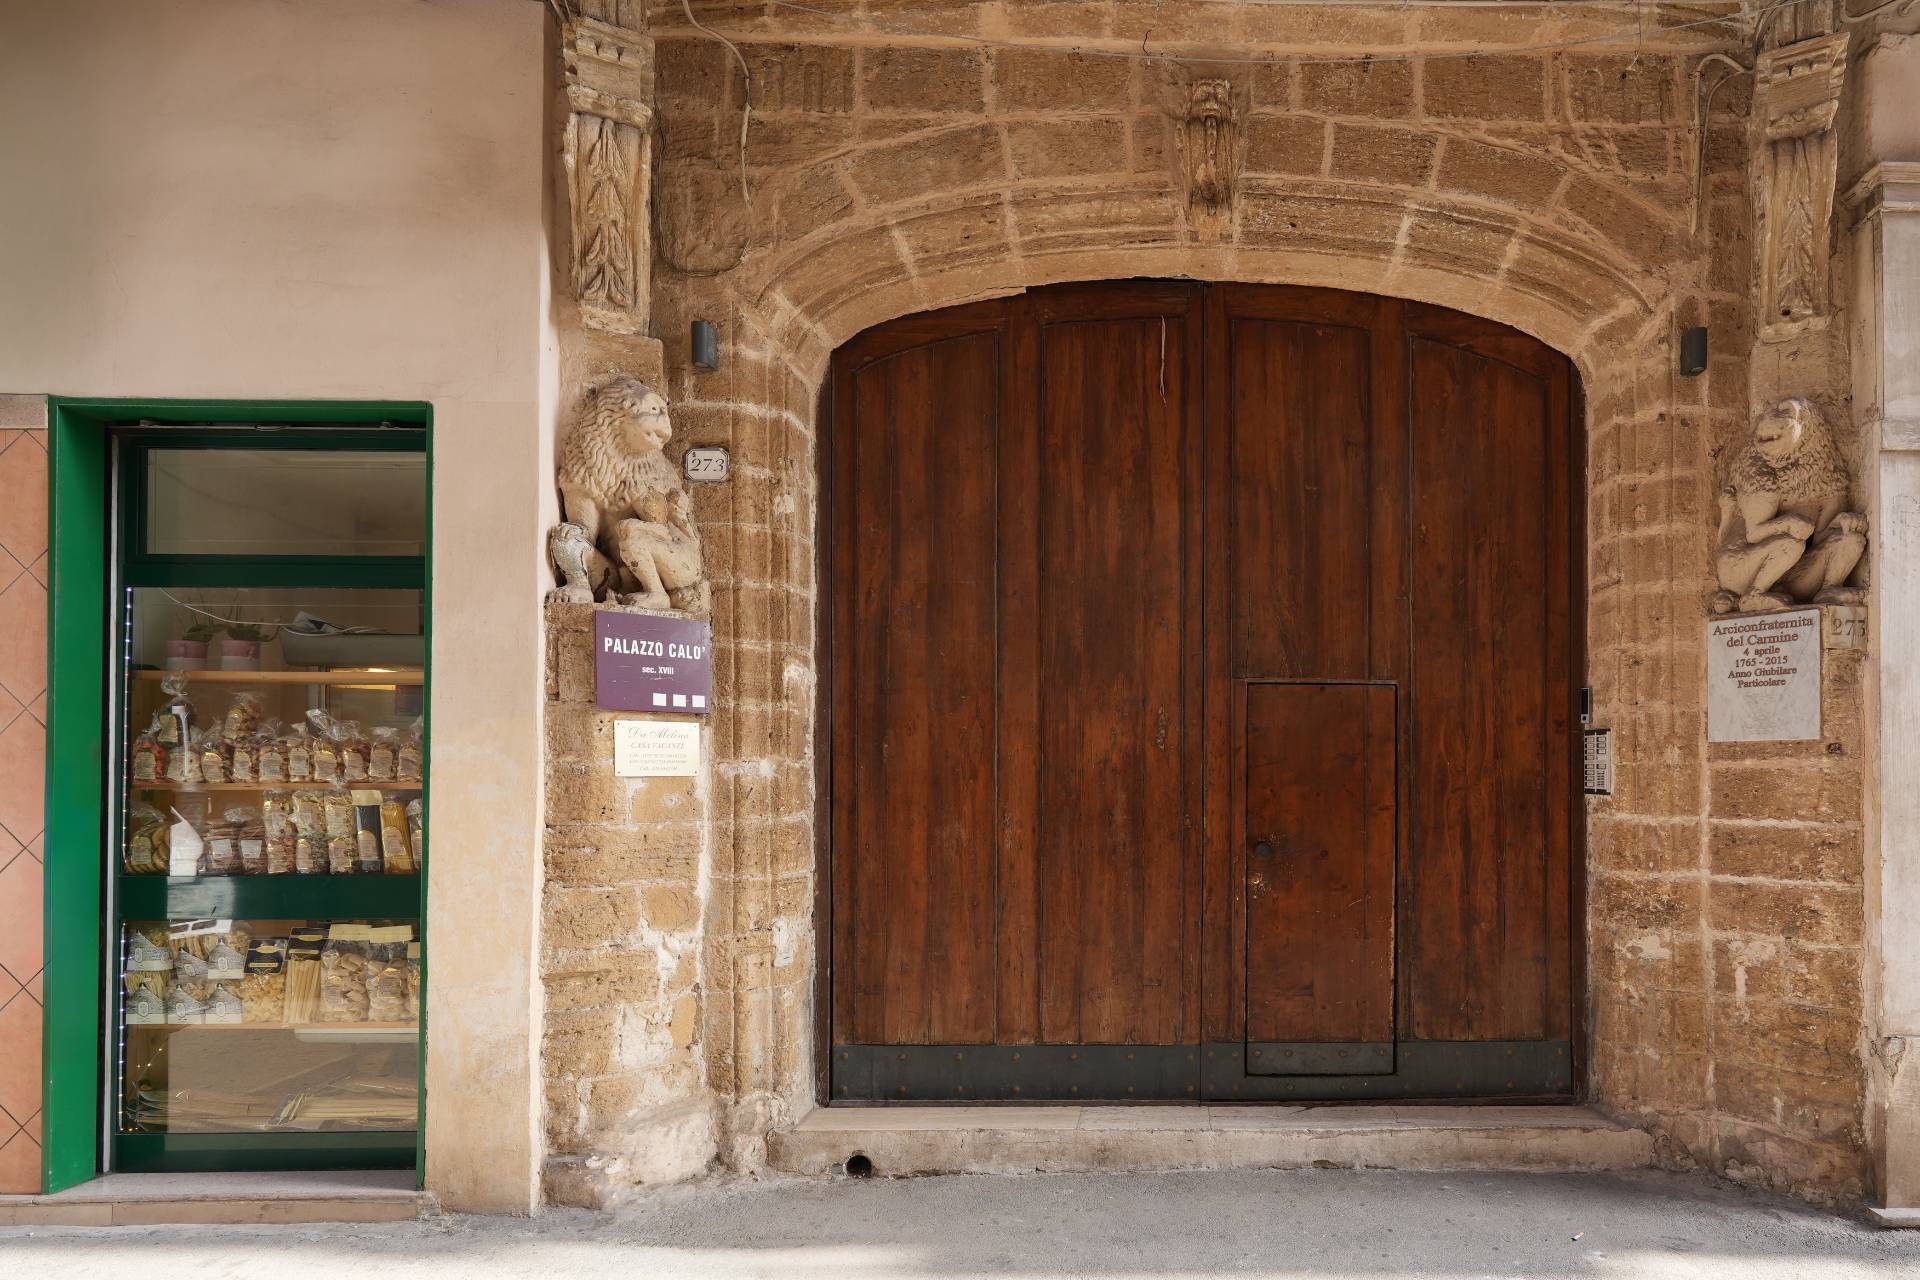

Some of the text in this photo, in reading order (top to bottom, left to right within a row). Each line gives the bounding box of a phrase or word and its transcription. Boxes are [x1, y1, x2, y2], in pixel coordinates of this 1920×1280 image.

[690, 459, 725, 472] 273
[1713, 616, 1814, 636] Arciconfraternita
[1832, 618, 1866, 637] 273
[1726, 631, 1799, 648] del Carmine
[604, 637, 663, 657] PALAZZO
[1743, 646, 1781, 658] 4 aprile
[1735, 658, 1756, 668] 1765
[1765, 656, 1788, 666] 2015
[641, 666, 674, 675] sec. XVIII
[1727, 667, 1798, 679] Anno Giubilare
[1736, 678, 1786, 688] Particolare
